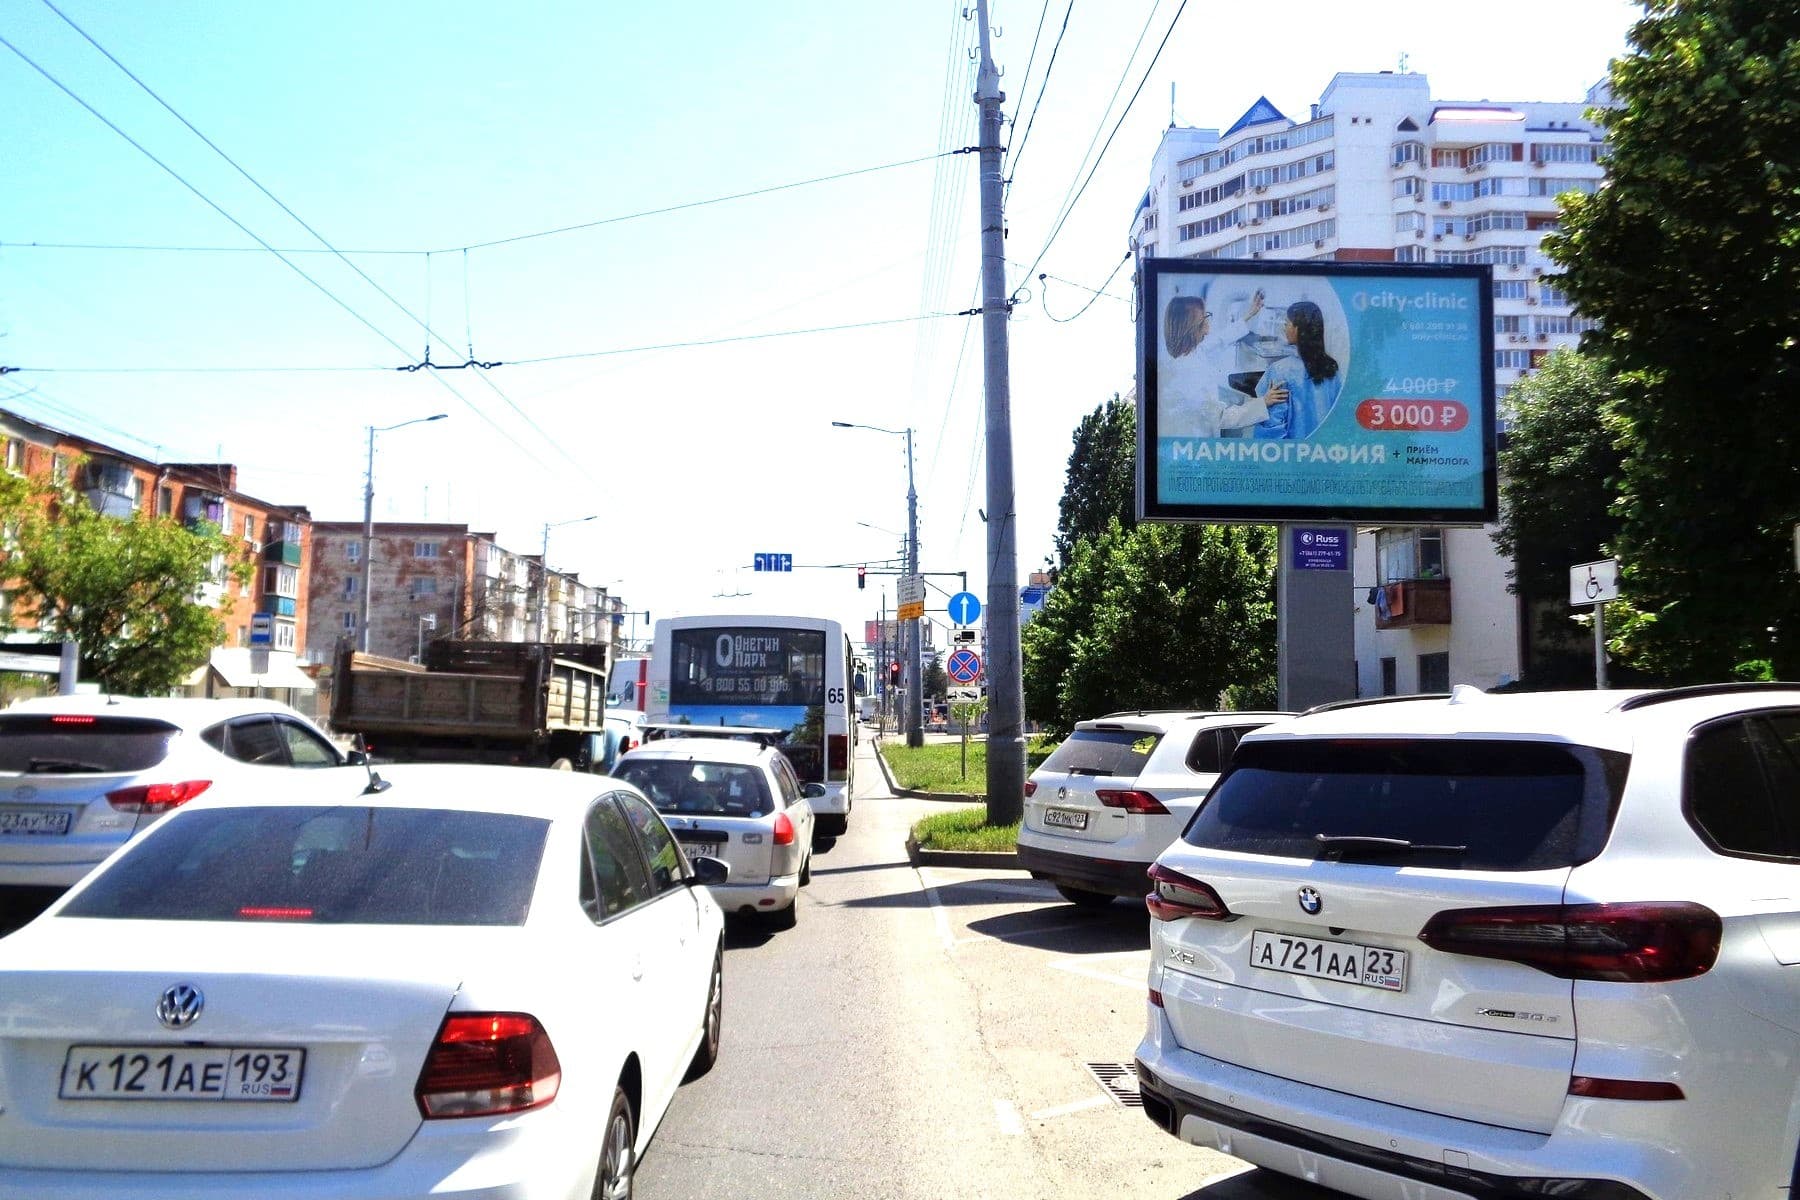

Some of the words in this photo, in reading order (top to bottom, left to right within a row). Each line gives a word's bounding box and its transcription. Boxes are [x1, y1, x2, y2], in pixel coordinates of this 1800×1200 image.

[1370, 291, 1468, 312] city-clinic
[1172, 440, 1385, 464] МАММОГРАФИЯ
[1406, 444, 1439, 455] ПРИЁМ
[1406, 456, 1470, 466] МАММОЛОГА
[1315, 534, 1339, 543] Russ
[828, 688, 845, 704] 65
[699, 844, 712, 855] 93
[1367, 949, 1394, 975] 23
[1364, 973, 1385, 985] RUS
[234, 1053, 291, 1082] 193
[240, 1083, 270, 1096] RUS
